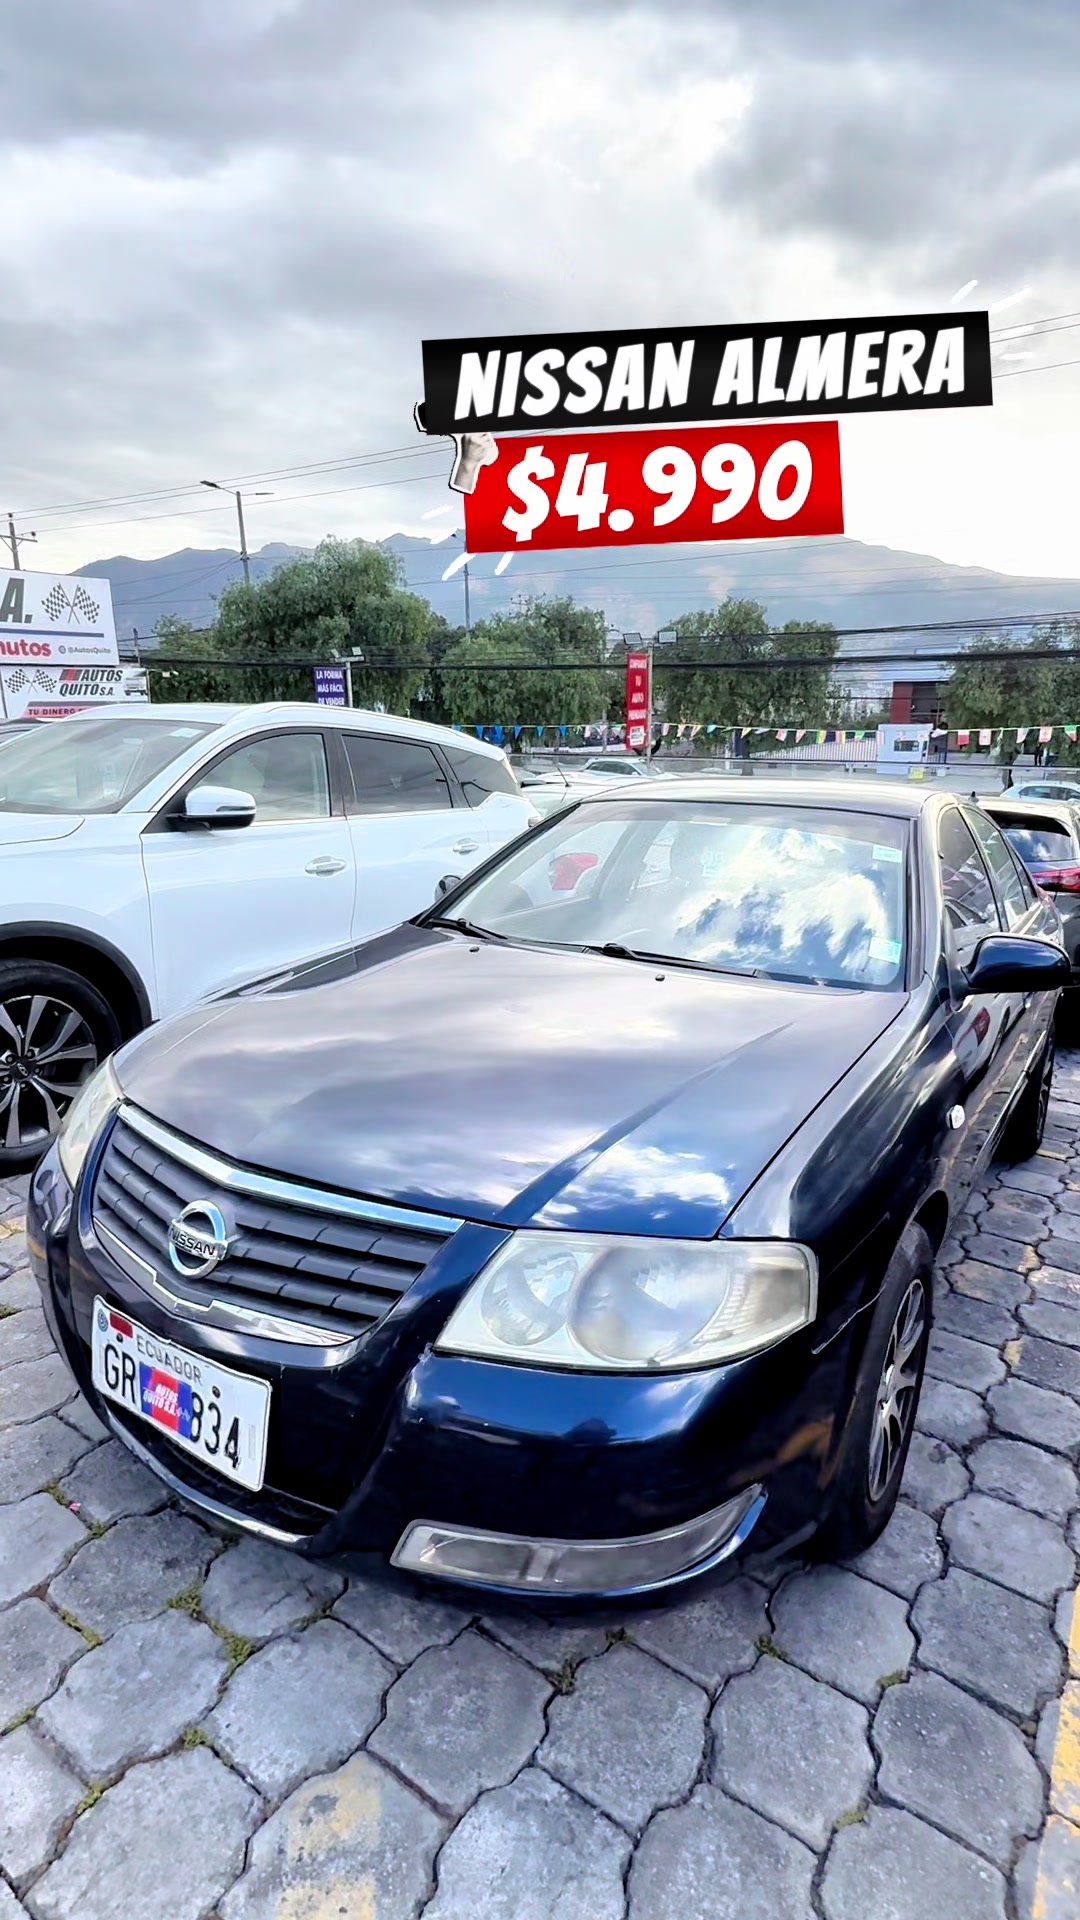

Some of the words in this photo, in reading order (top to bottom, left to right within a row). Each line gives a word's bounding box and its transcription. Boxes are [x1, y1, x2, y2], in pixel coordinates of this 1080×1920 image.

[81, 669, 123, 682] AUTOS
[316, 670, 323, 679] LA
[324, 670, 343, 679] FORMA
[59, 683, 99, 697] QUITO
[326, 697, 345, 706] VENDER
[168, 1226, 216, 1256] NISSAN
[136, 1334, 203, 1386] ECUADOR
[104, 1343, 137, 1404] GR
[143, 1390, 165, 1409] QUITO
